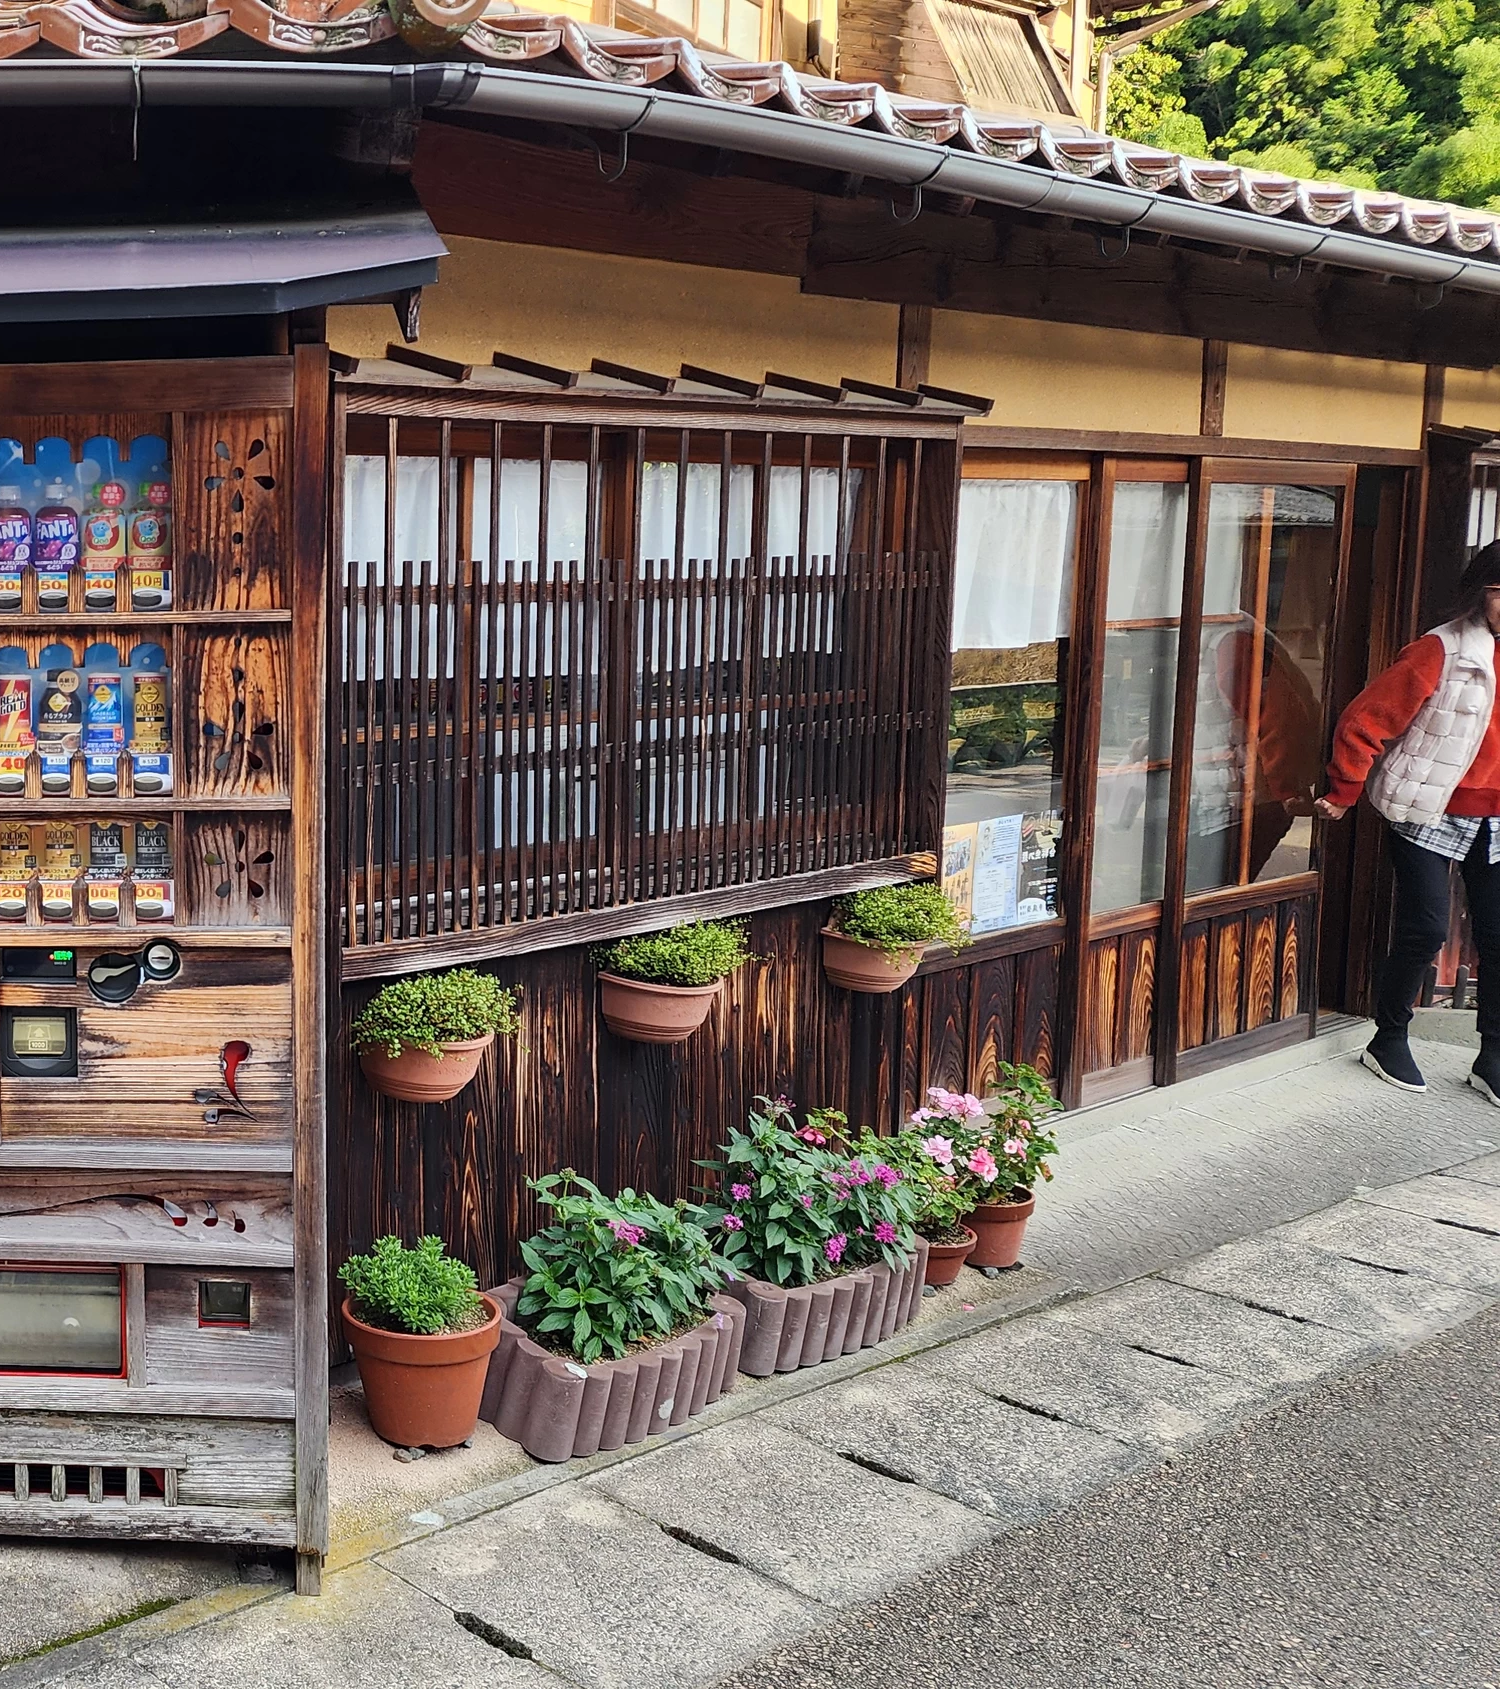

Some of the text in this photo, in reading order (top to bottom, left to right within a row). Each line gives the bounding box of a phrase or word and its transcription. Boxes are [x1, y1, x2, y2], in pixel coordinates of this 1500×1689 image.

[36, 519, 74, 540] FANTA
[0, 701, 27, 715] GOLD
[135, 703, 165, 713] GOLDEN
[0, 831, 29, 840] GOLDEN
[45, 830, 75, 840] GOLDEN
[91, 836, 120, 847] BLACK
[137, 836, 166, 847] BLACK
